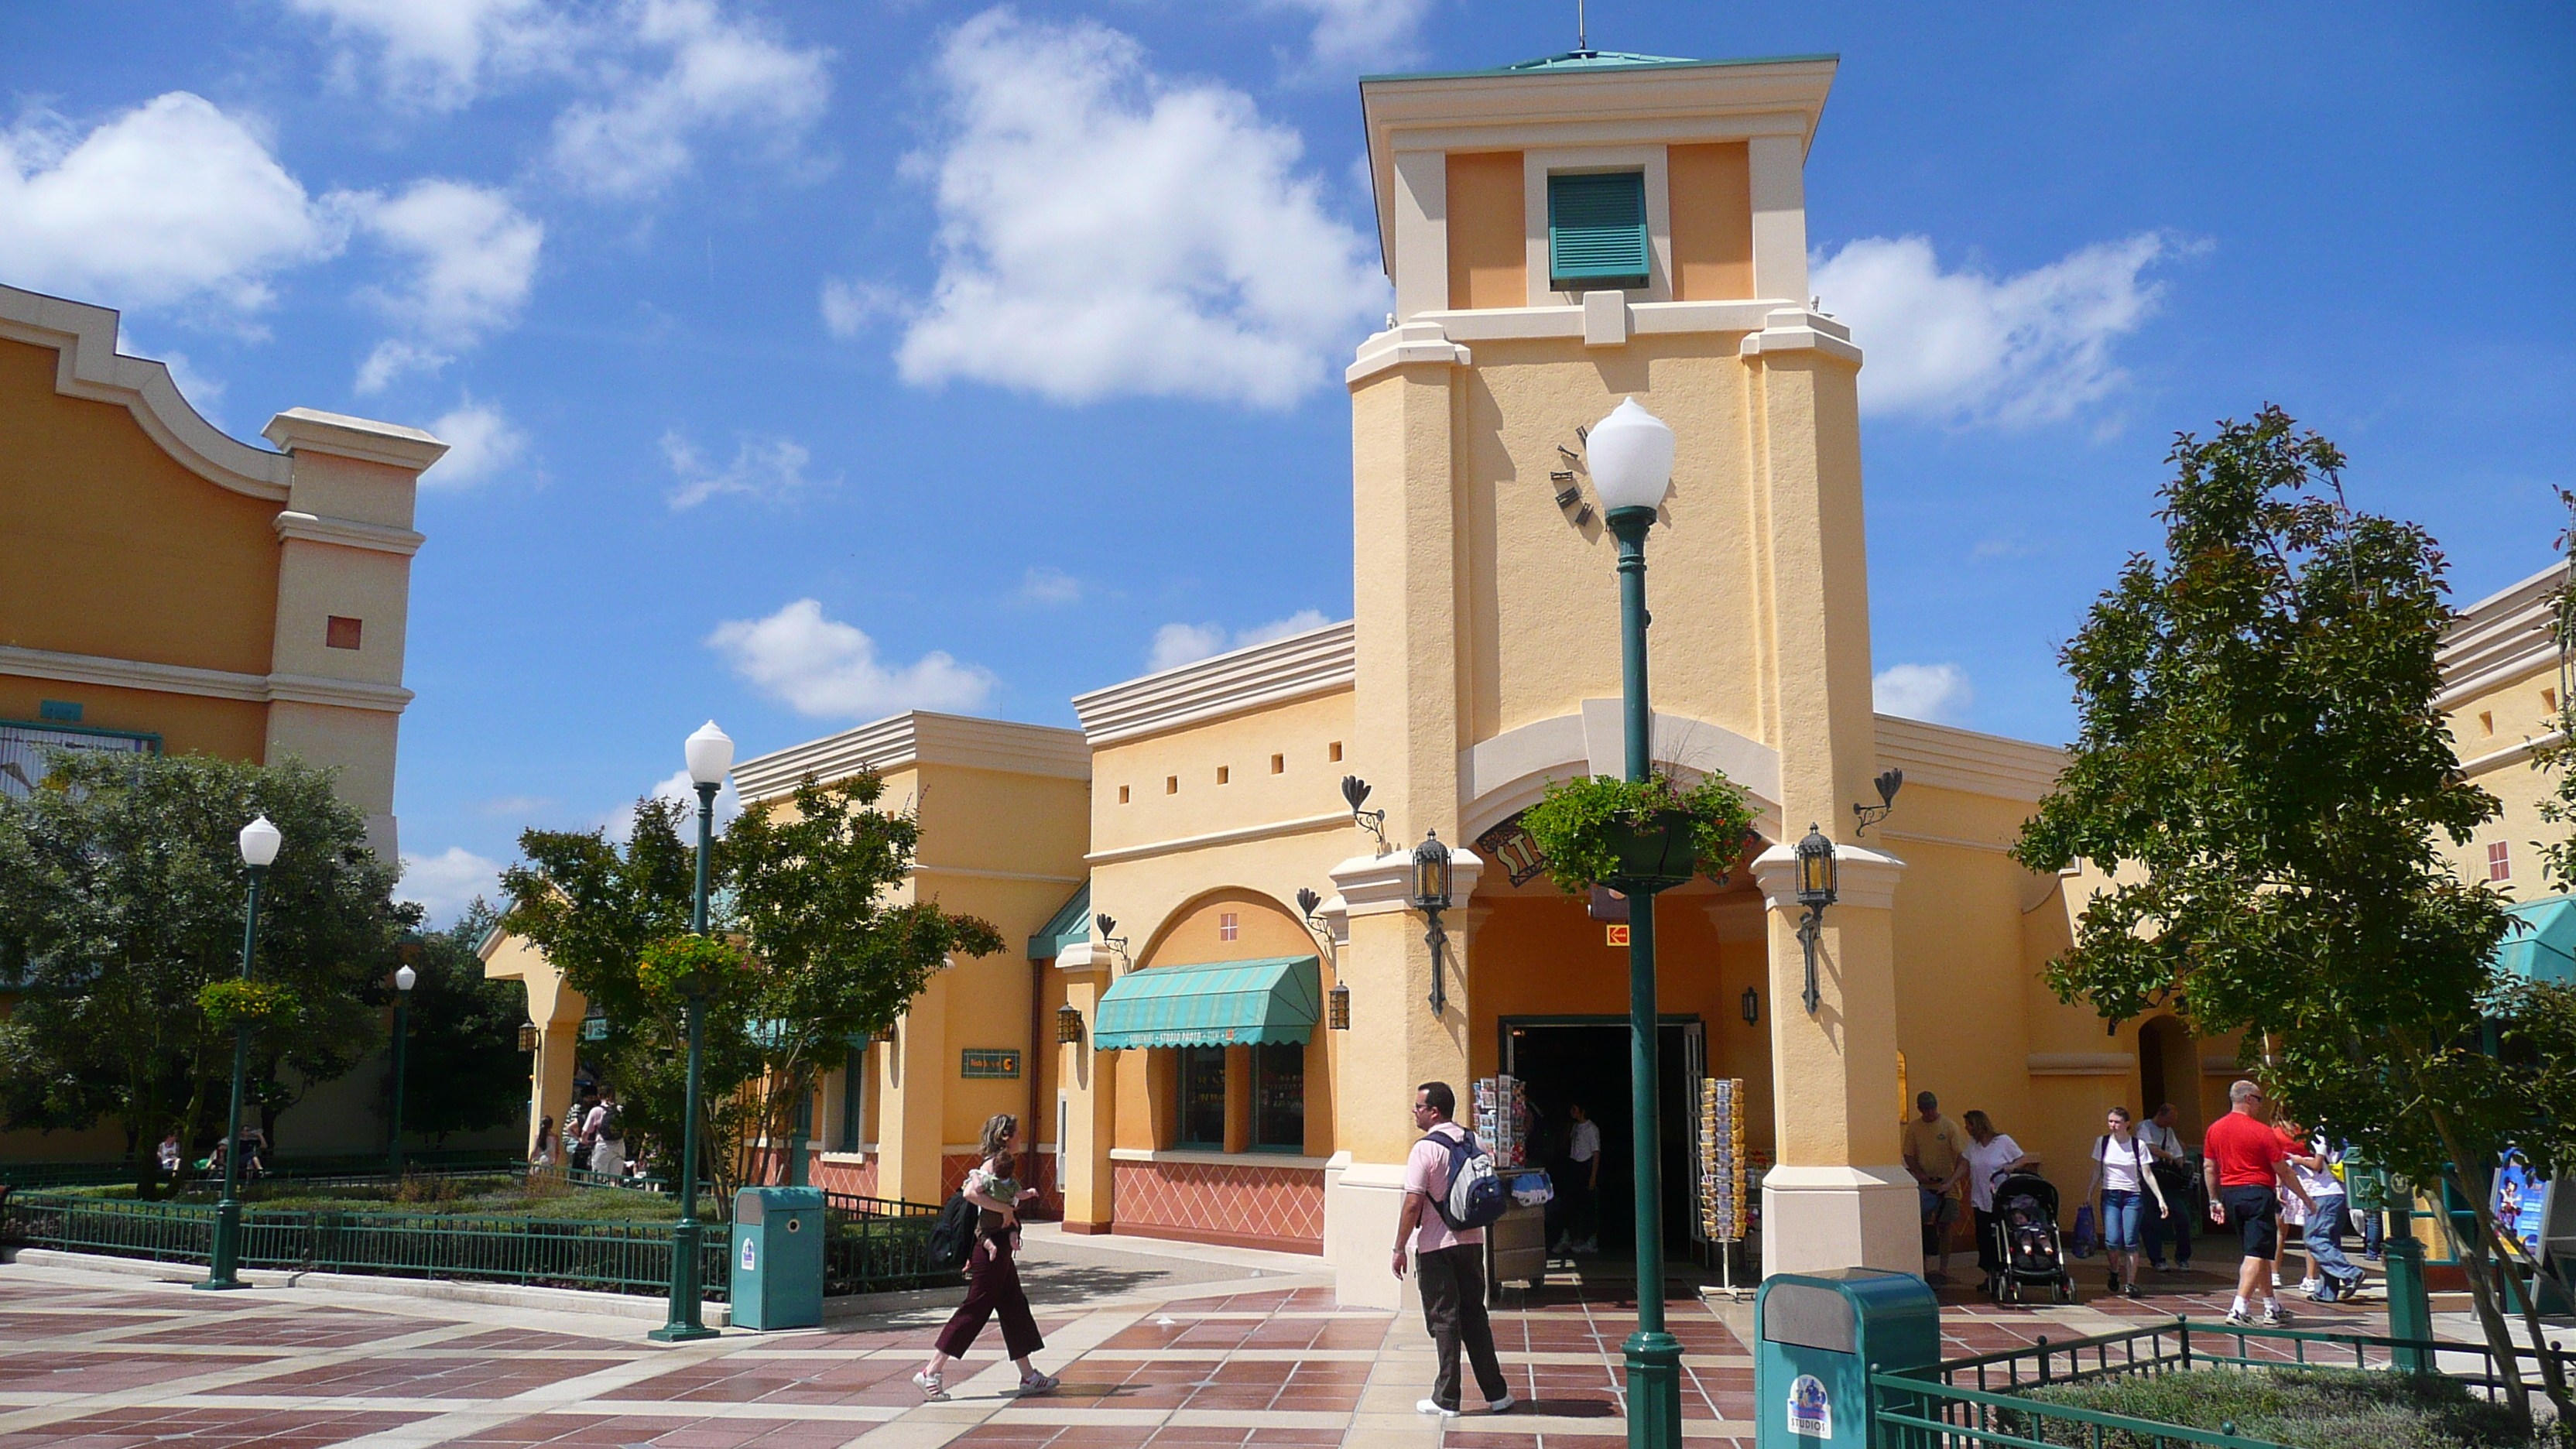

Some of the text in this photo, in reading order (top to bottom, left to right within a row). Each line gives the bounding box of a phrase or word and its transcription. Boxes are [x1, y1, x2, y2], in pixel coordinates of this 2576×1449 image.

[1160, 1032, 1180, 1043] STUDIO
[1182, 1031, 1201, 1042] PHOTO
[1791, 1417, 1825, 1432] STUDIOS
